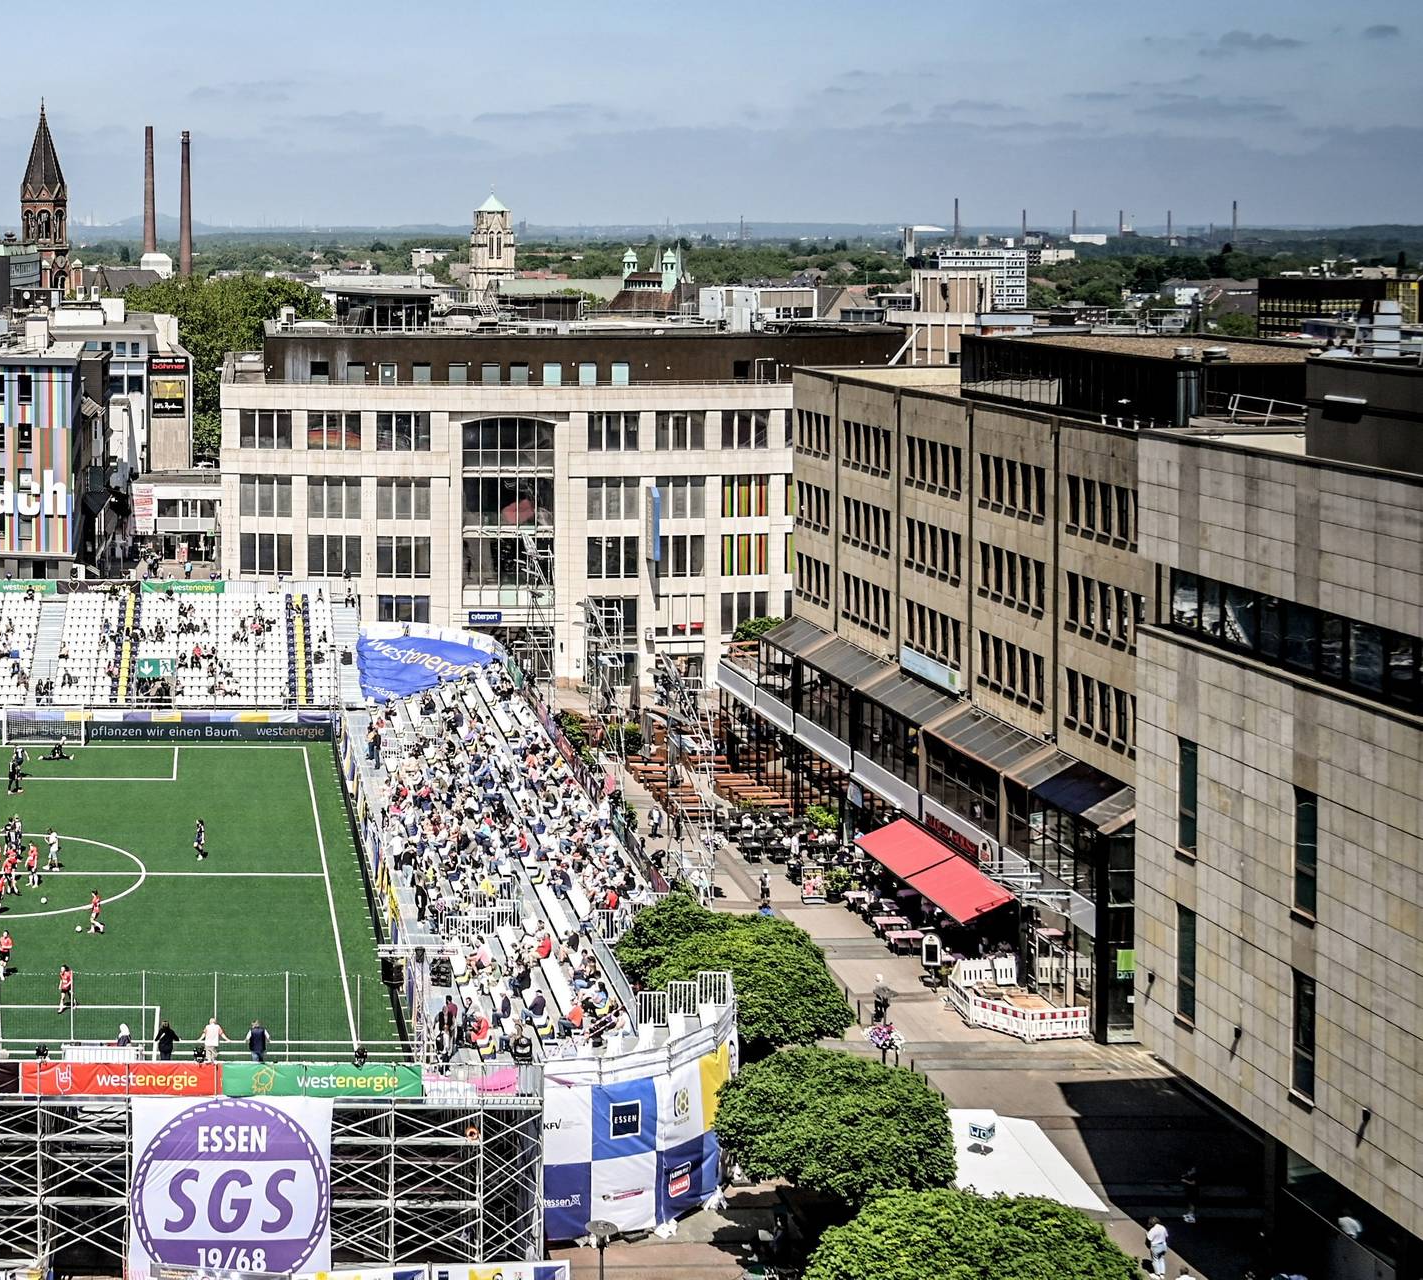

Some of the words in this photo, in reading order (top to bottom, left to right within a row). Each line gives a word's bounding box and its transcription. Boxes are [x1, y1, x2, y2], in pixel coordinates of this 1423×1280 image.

[172, 583, 215, 593] westenergie
[91, 725, 142, 738] pflanzen
[146, 726, 165, 736] wir
[169, 726, 201, 737] einen
[206, 726, 242, 737] Baum.
[256, 725, 325, 738] westenergie
[97, 1071, 197, 1089] westenergie
[297, 1071, 399, 1089] westenergie
[543, 1118, 562, 1130] KFV
[614, 1114, 638, 1124] ESSEN
[197, 1125, 267, 1152] ESSEN
[163, 1168, 297, 1234] SGS
[197, 1247, 267, 1272] 19/68
